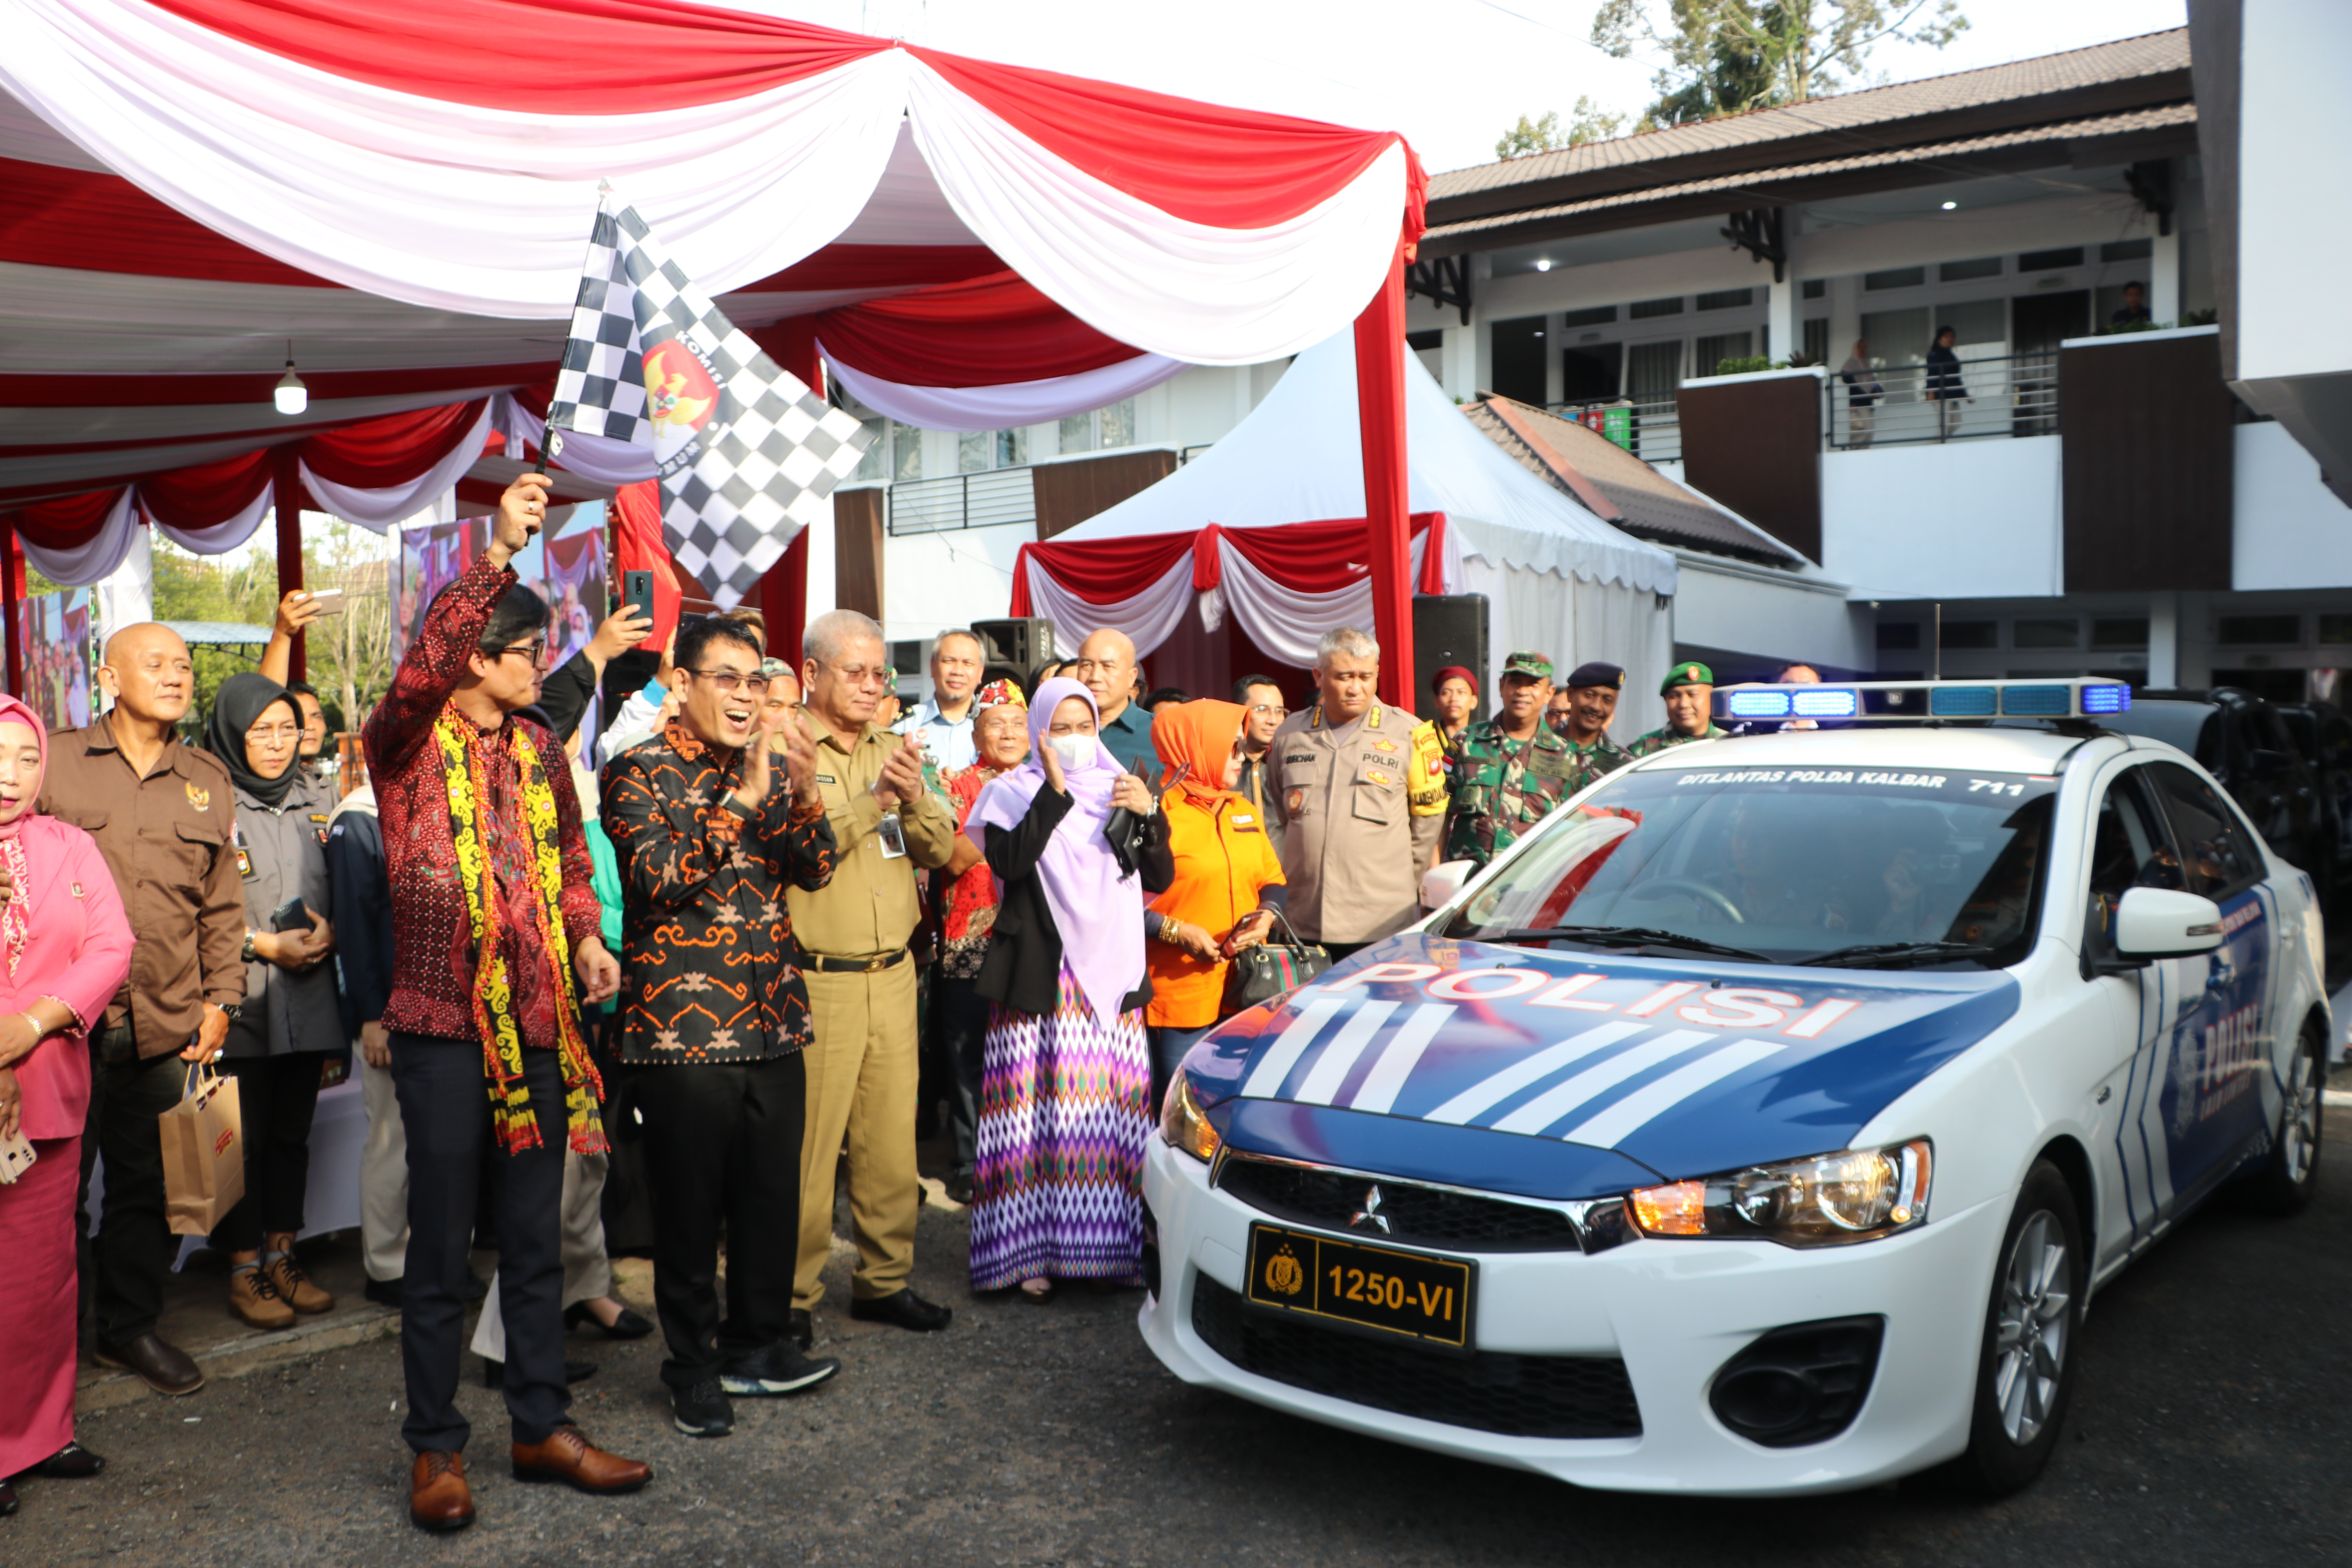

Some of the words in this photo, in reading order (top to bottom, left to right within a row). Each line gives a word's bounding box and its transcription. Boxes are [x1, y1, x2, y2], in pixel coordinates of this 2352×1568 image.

[675, 330, 727, 389] KOMISI
[1421, 733, 1435, 744] POLDA
[1363, 753, 1399, 769] POLRI
[1677, 770, 1786, 785] DITLANTAS
[1786, 770, 1854, 783] POLDA
[1856, 771, 1947, 788] KALBAR
[1968, 779, 2025, 797] 711
[1319, 962, 1863, 1040] POLISI
[1329, 1265, 1453, 1320] 1250-VI
